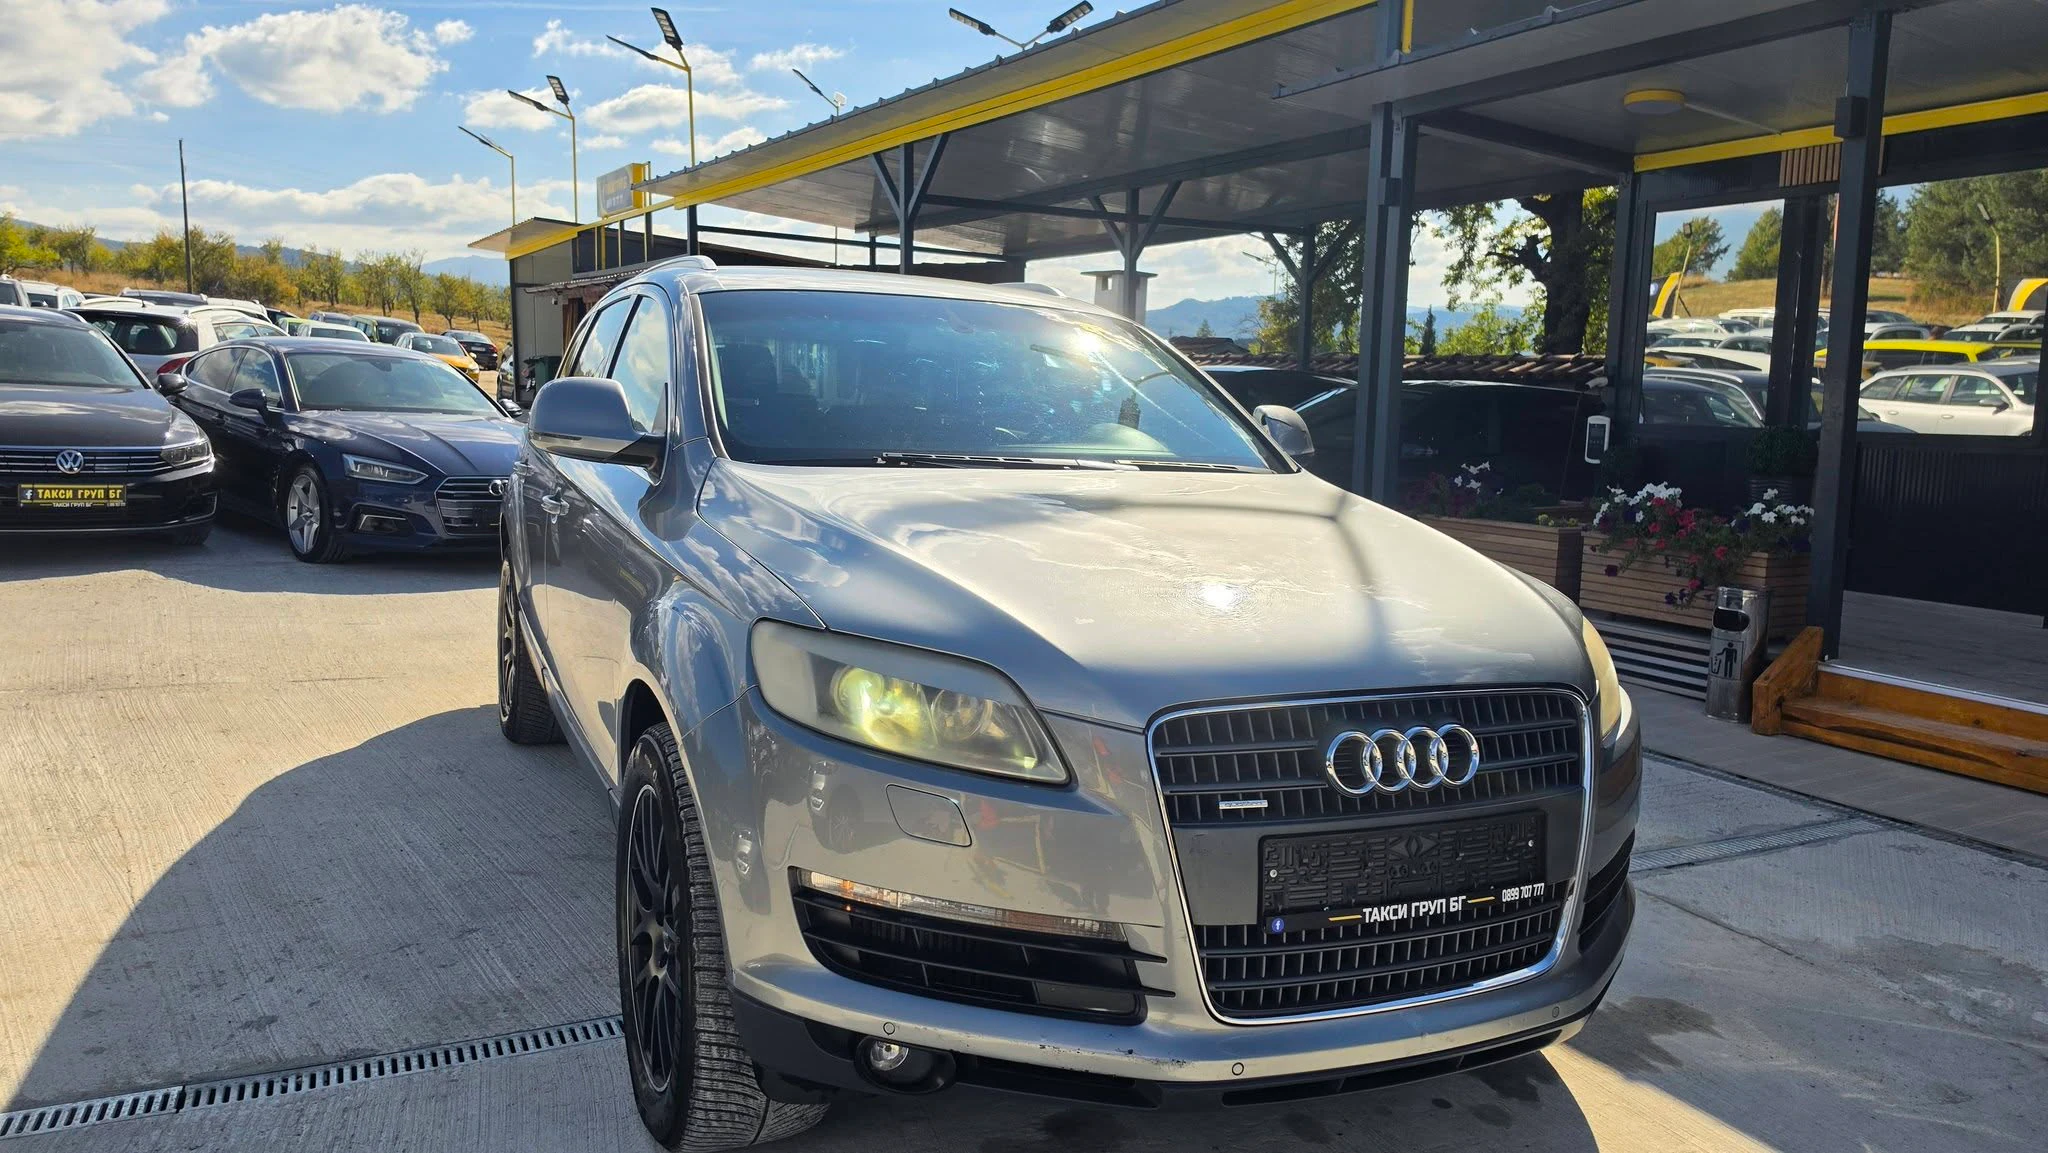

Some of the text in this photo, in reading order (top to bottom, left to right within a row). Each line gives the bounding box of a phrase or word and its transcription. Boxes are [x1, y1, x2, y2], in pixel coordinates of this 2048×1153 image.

[37, 489, 122, 499] ТАКСИ ГРУП БГ
[1362, 882, 1545, 923] ТАКСИ ГРУП БГ 0899 707 777
